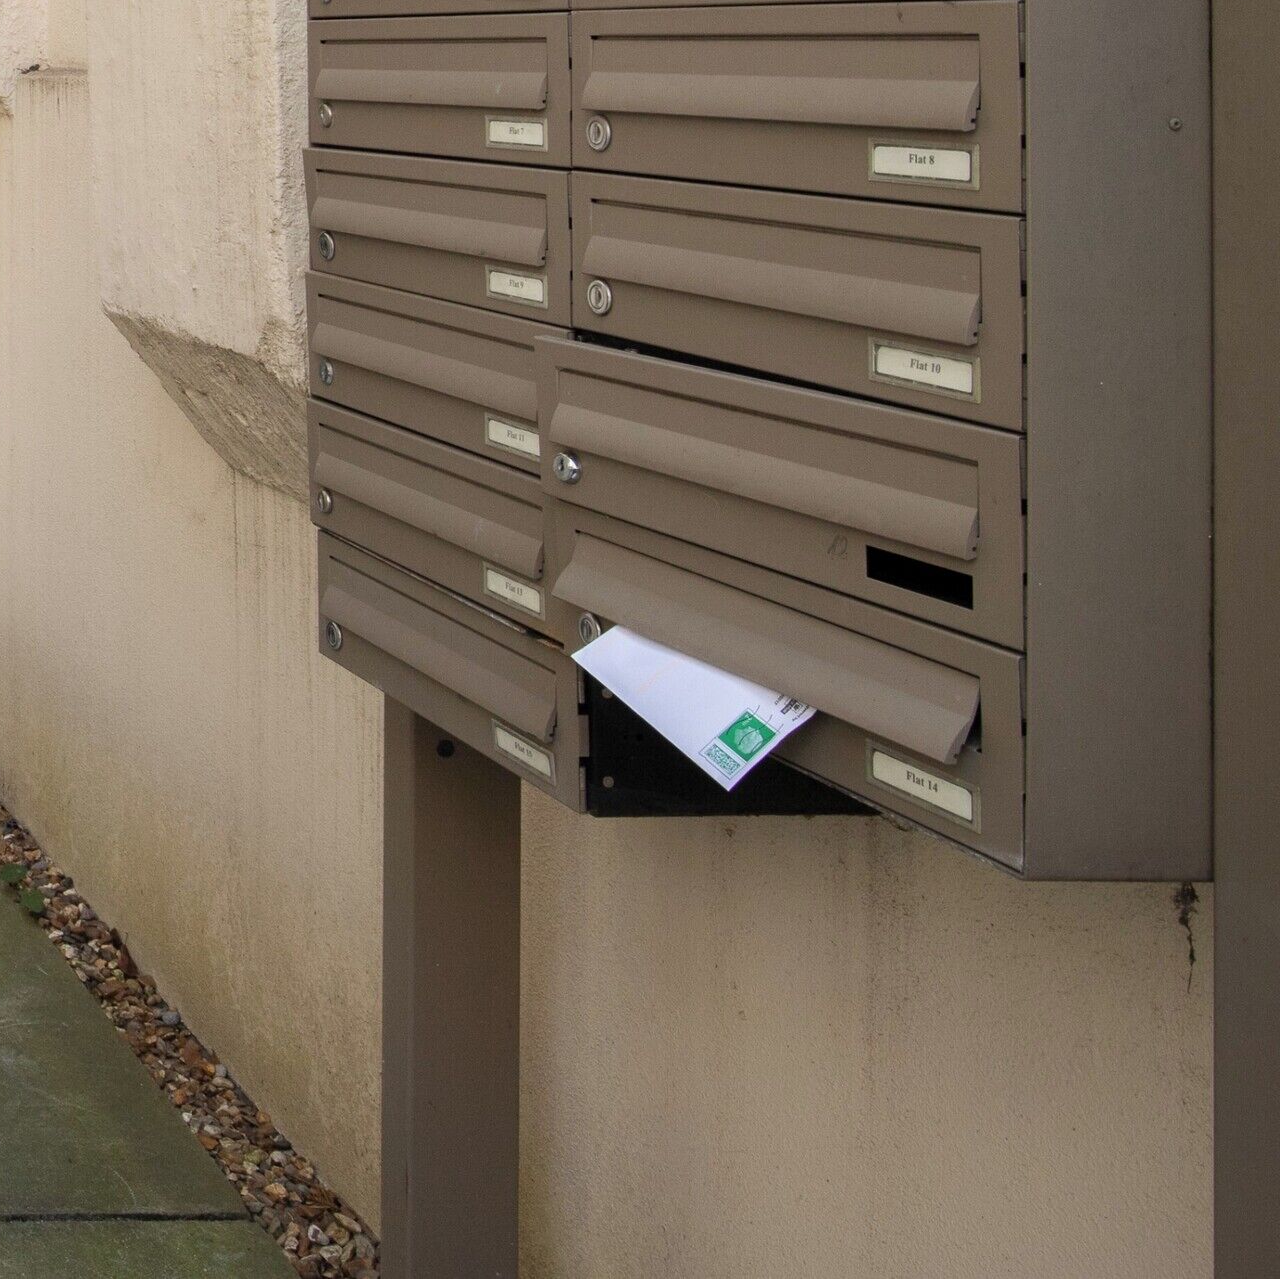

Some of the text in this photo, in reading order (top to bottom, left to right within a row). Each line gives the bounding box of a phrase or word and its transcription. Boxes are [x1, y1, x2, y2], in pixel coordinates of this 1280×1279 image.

[908, 153, 935, 165] Flat 8
[910, 358, 941, 374] Flat 10
[906, 770, 938, 793] Flat 14
